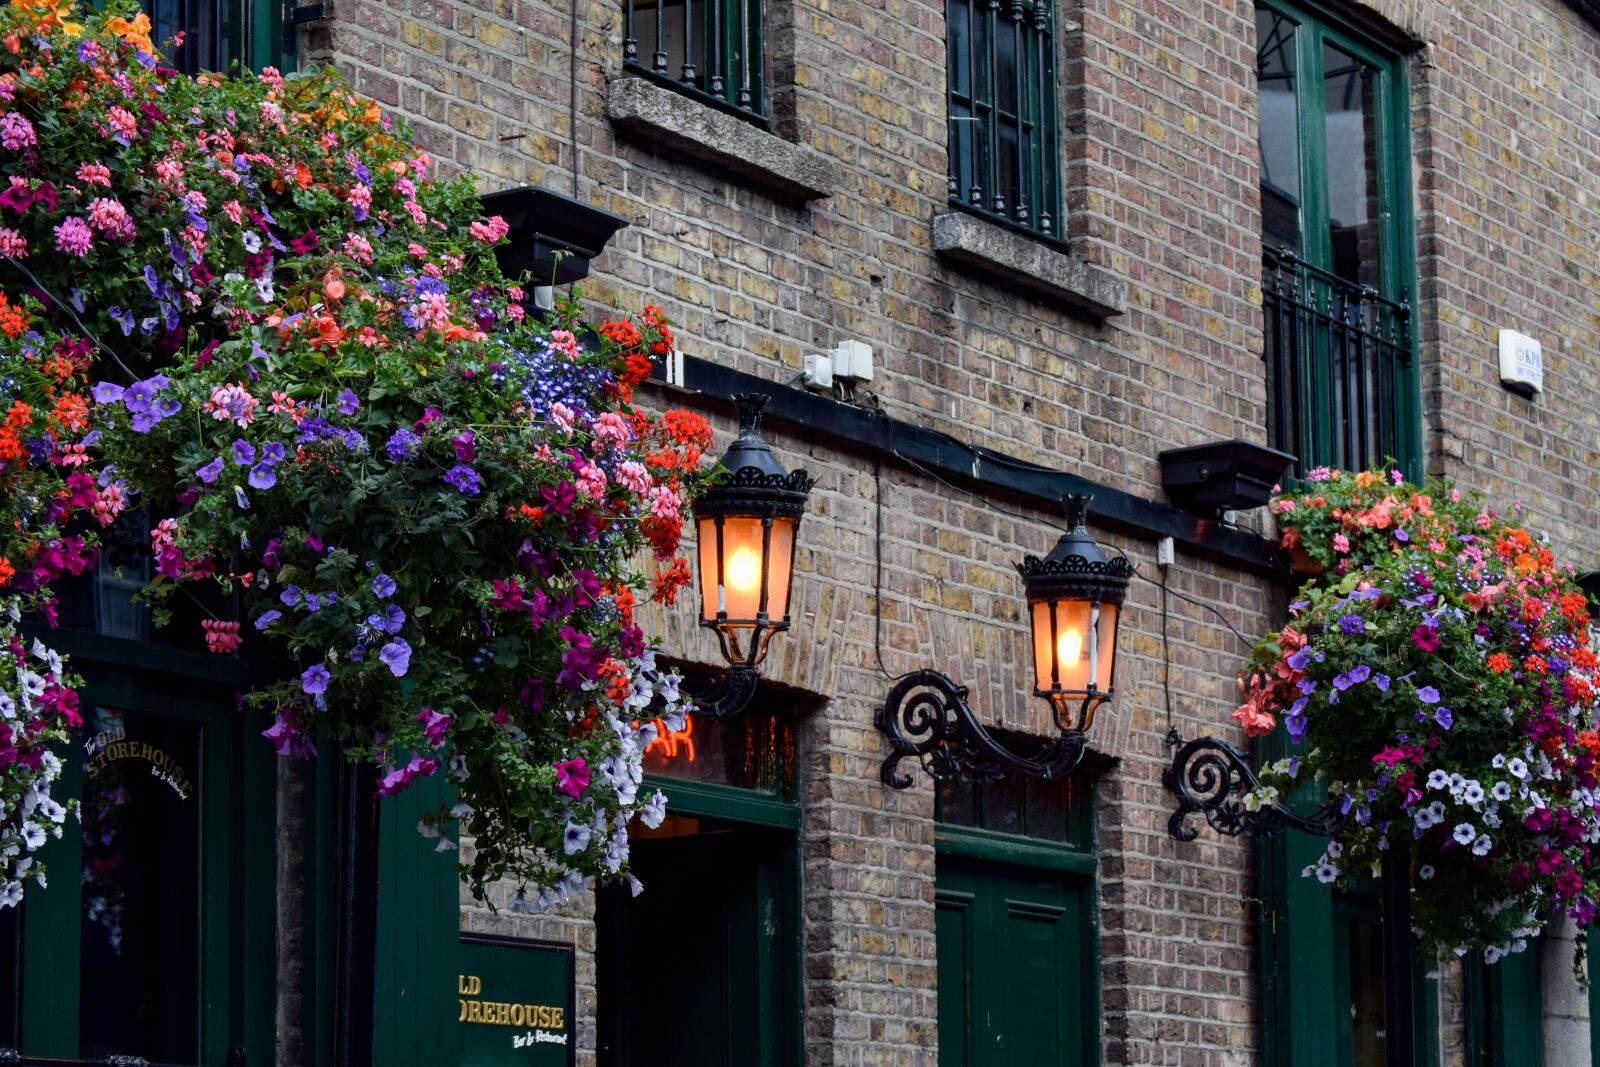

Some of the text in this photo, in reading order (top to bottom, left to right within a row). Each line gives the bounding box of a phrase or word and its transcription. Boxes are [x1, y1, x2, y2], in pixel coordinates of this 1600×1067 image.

[96, 726, 126, 747] OLD
[643, 714, 695, 762] AR
[86, 741, 193, 795] STOREHOUSE
[512, 1034, 527, 1049] Bar
